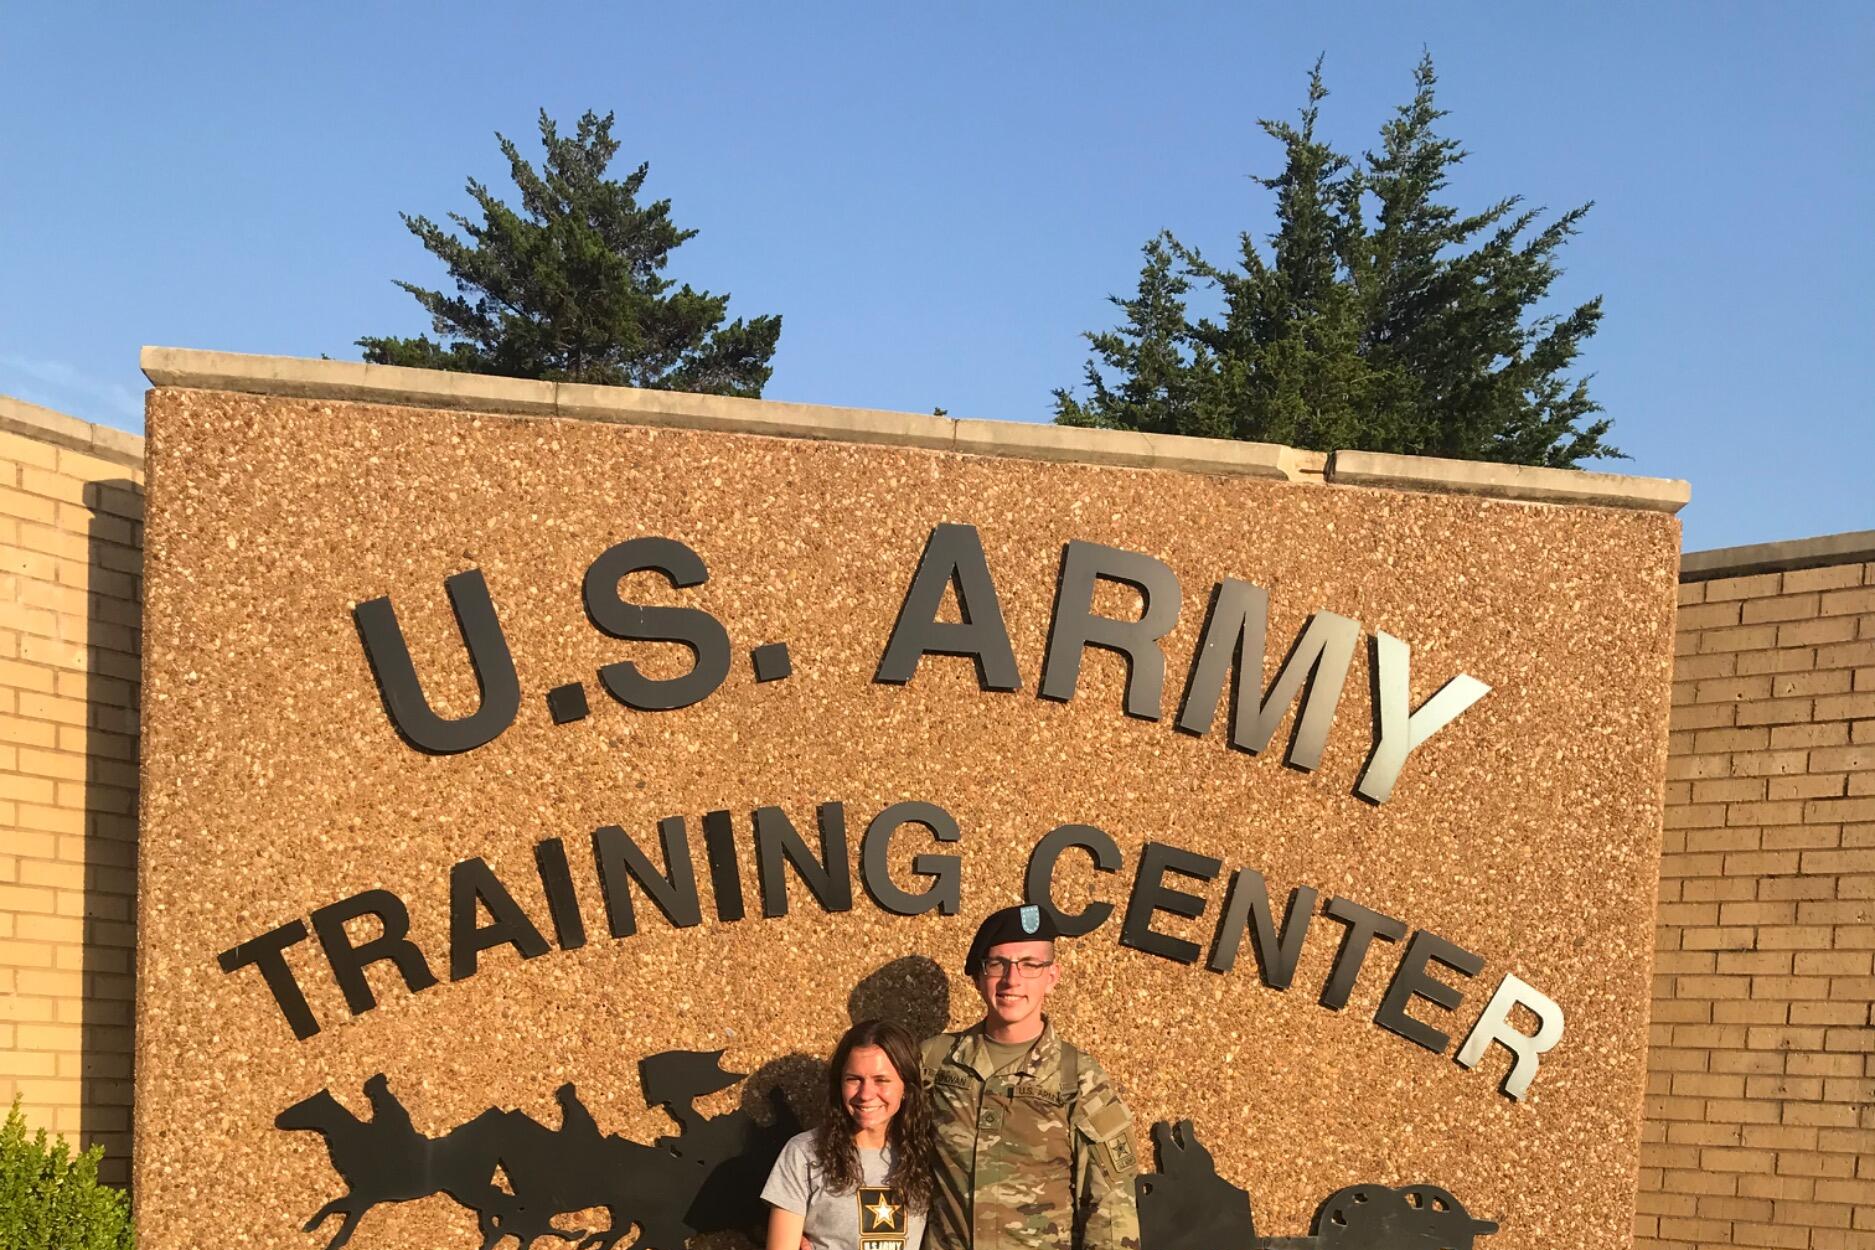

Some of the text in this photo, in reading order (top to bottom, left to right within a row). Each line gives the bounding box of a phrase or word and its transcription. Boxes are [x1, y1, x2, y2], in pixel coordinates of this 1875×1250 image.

[352, 523, 1492, 805] U.S. ARMY
[217, 801, 1566, 1102] TRAINING CENTER
